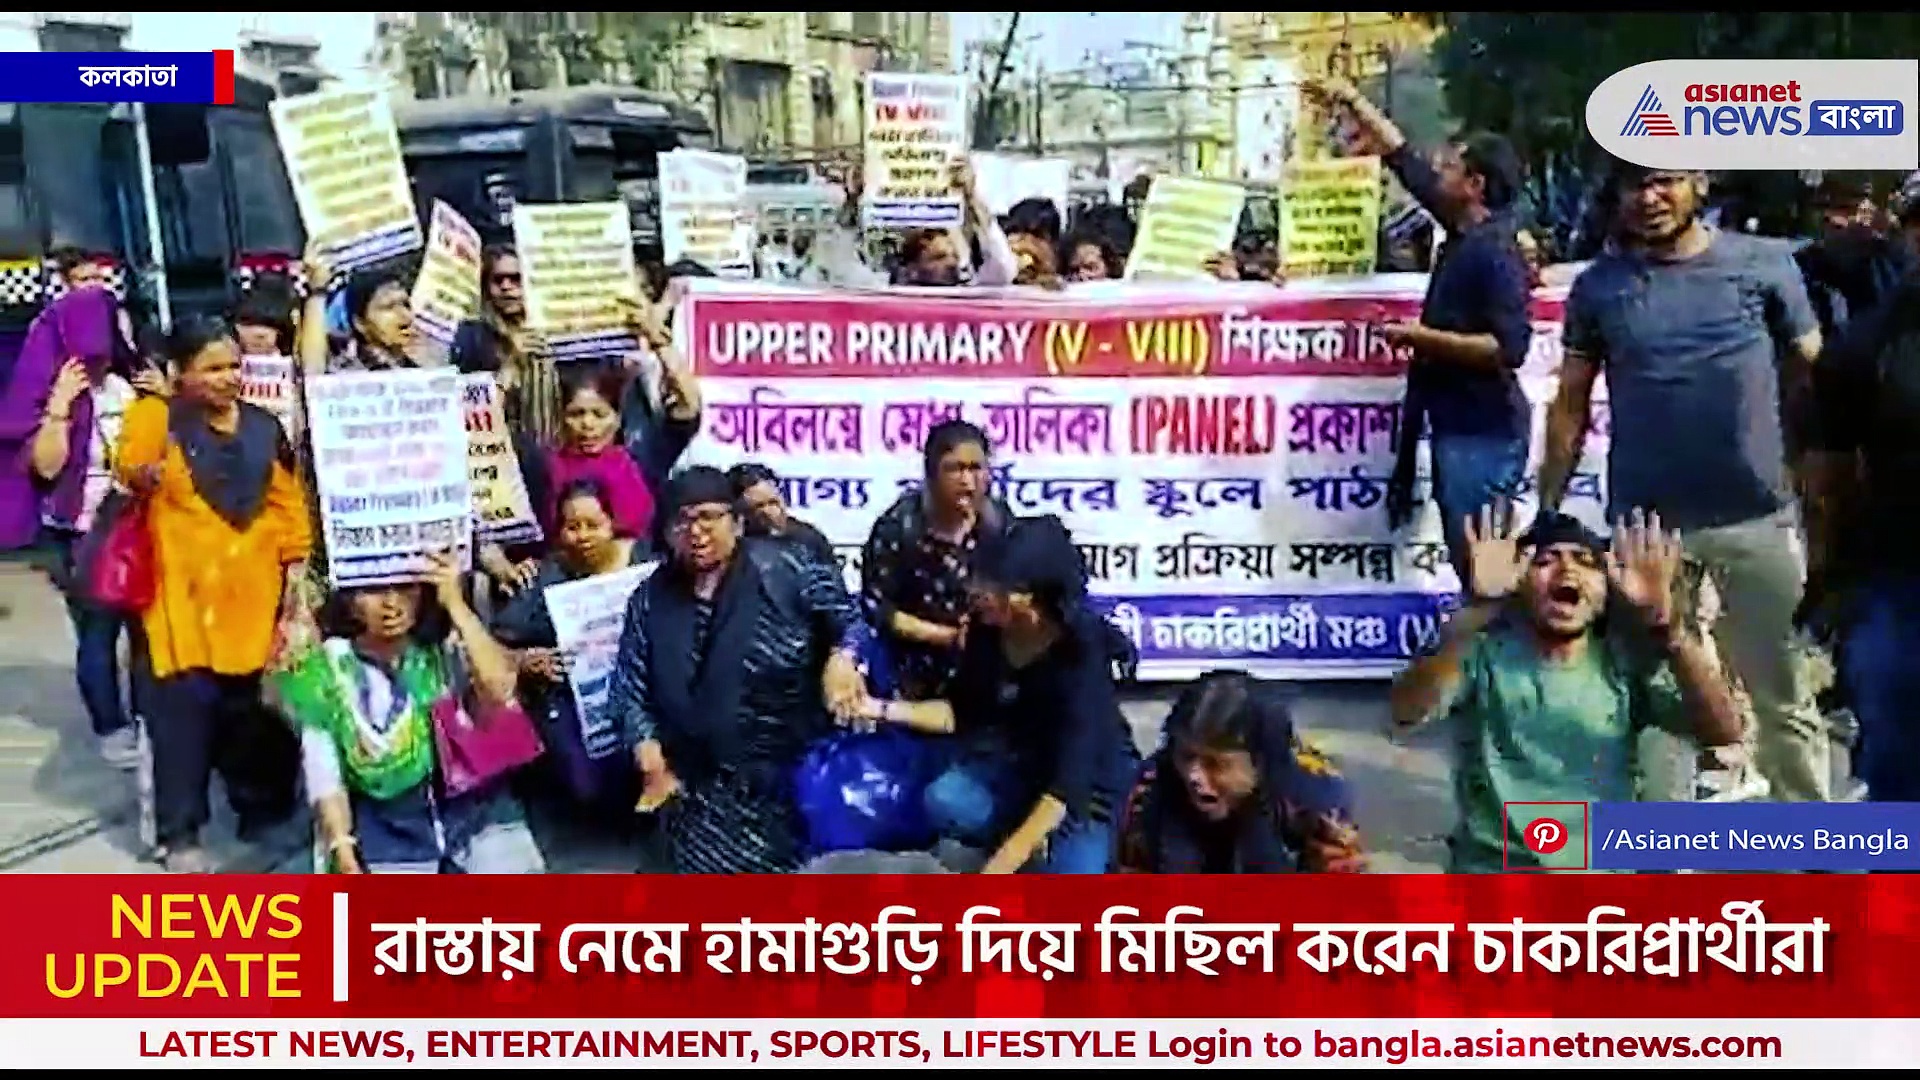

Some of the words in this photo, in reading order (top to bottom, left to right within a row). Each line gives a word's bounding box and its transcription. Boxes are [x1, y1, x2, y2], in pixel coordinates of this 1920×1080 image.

[709, 321, 833, 363] UPPER
[848, 321, 1033, 365] PRIMARY
[1127, 322, 1210, 372] VIII)
[1220, 307, 1346, 364] শিক্ষক
[708, 387, 862, 454] অবিলম্বে
[981, 387, 1114, 455] তালিকা
[1131, 396, 1275, 455] (PANEL)
[1141, 476, 1262, 518] স্কুলে
[1155, 532, 1276, 580] প্রক্রিয়া
[1289, 542, 1396, 583] সম্পন্ন
[1150, 602, 1319, 654] চাকরিপ্রার্থী
[1324, 613, 1387, 648] মঞ্চ
